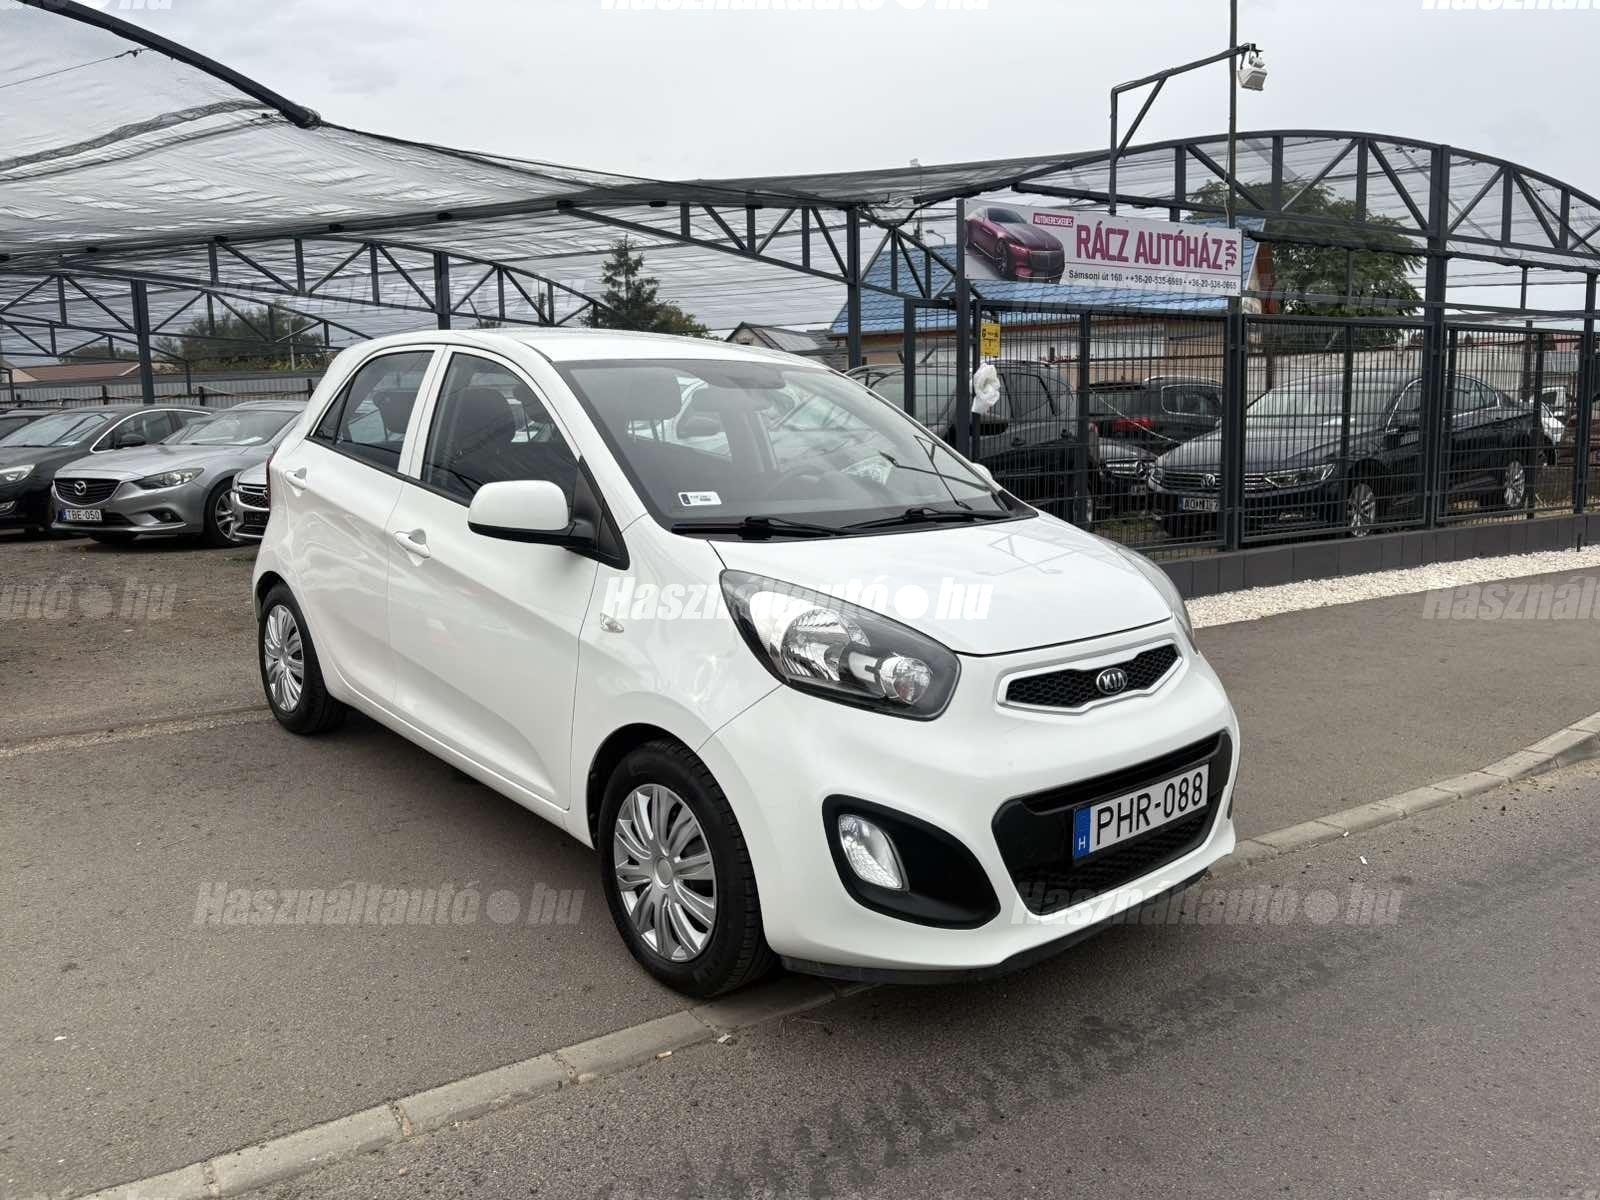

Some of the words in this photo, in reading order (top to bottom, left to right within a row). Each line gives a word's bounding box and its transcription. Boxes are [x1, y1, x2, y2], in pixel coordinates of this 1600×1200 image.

[1076, 220, 1129, 262] RÁCZ
[1134, 229, 1223, 270] AUTÓHÁZ
[1102, 672, 1126, 690] KIA
[1096, 771, 1203, 846] PHR-088
[1078, 835, 1086, 850] H
